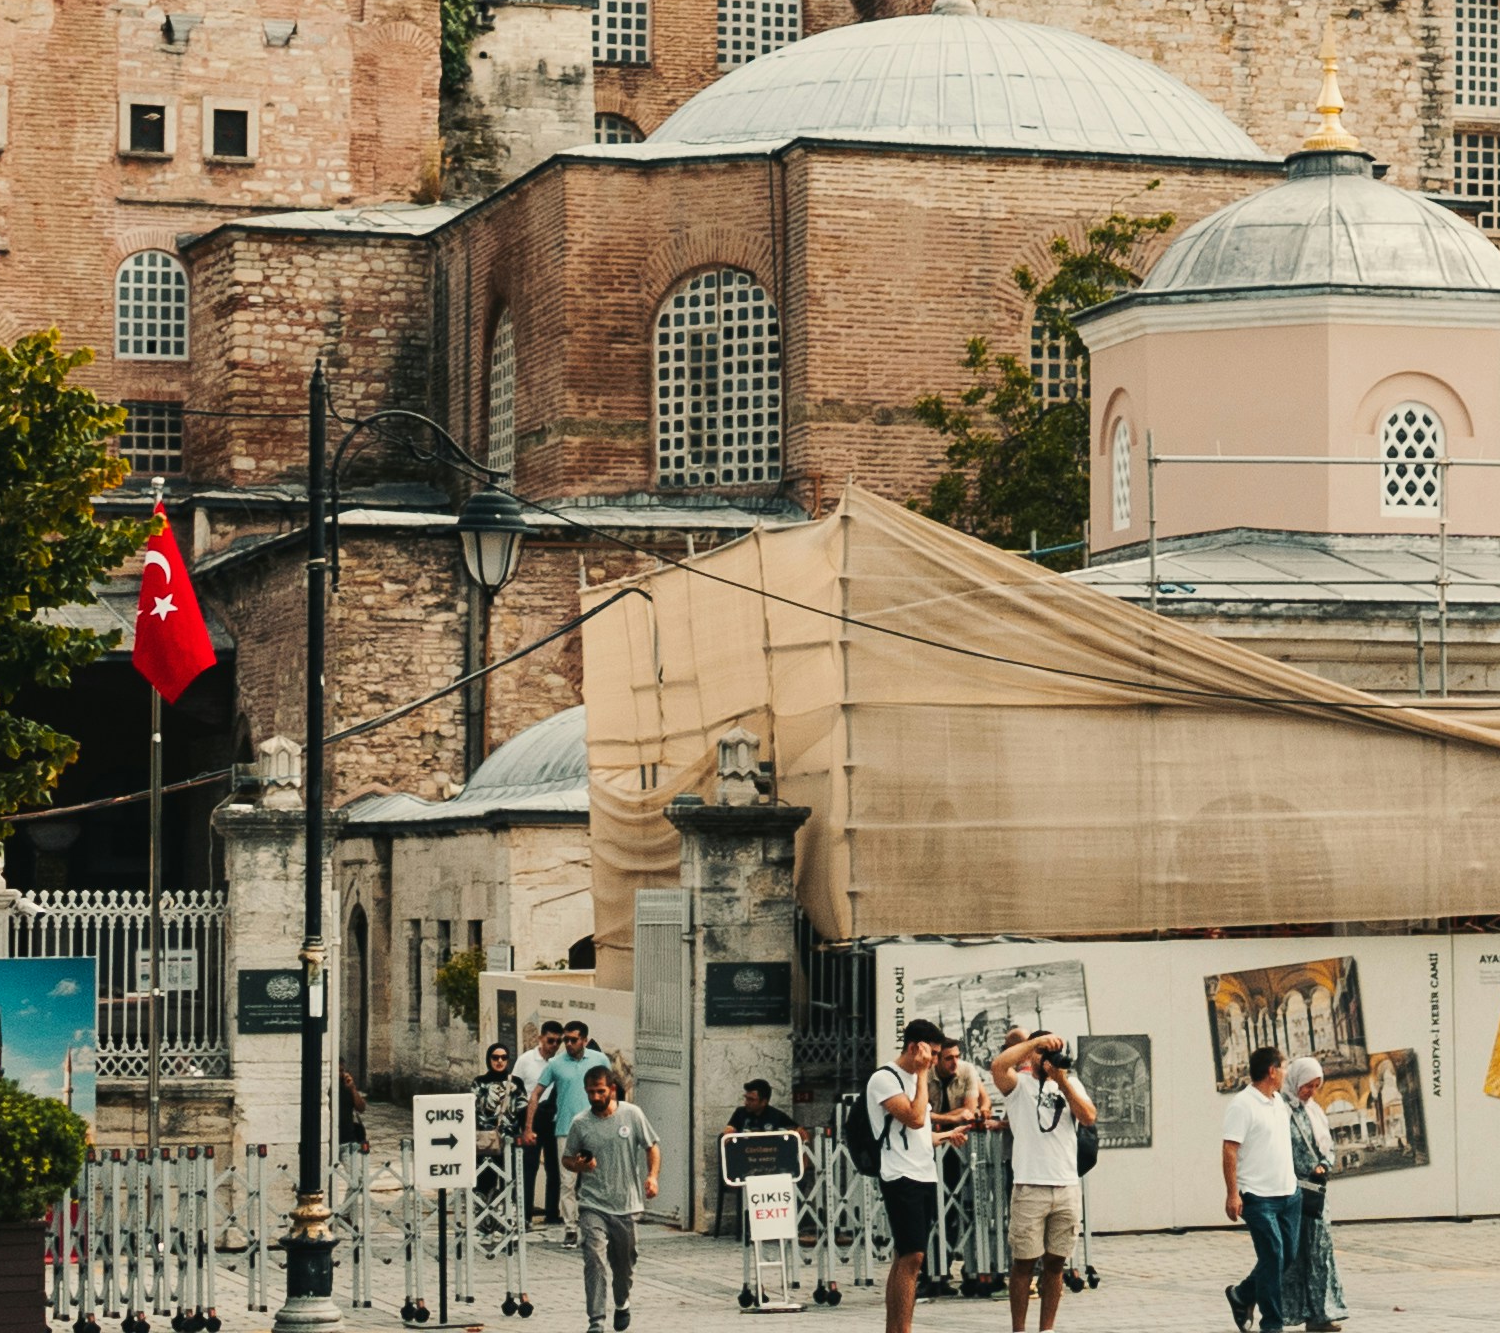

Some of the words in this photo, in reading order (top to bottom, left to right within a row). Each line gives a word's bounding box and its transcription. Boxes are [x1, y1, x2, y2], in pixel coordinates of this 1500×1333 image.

[1428, 952, 1439, 988] CAMİİ
[894, 966, 904, 1004] CAMİİ
[1430, 992, 1440, 1026] KEBİR
[425, 1109, 465, 1124] ÇIKIŞ
[430, 1163, 462, 1176] EXIT
[751, 1192, 792, 1206] ÇIKIŞ
[755, 1208, 790, 1220] EXIT
